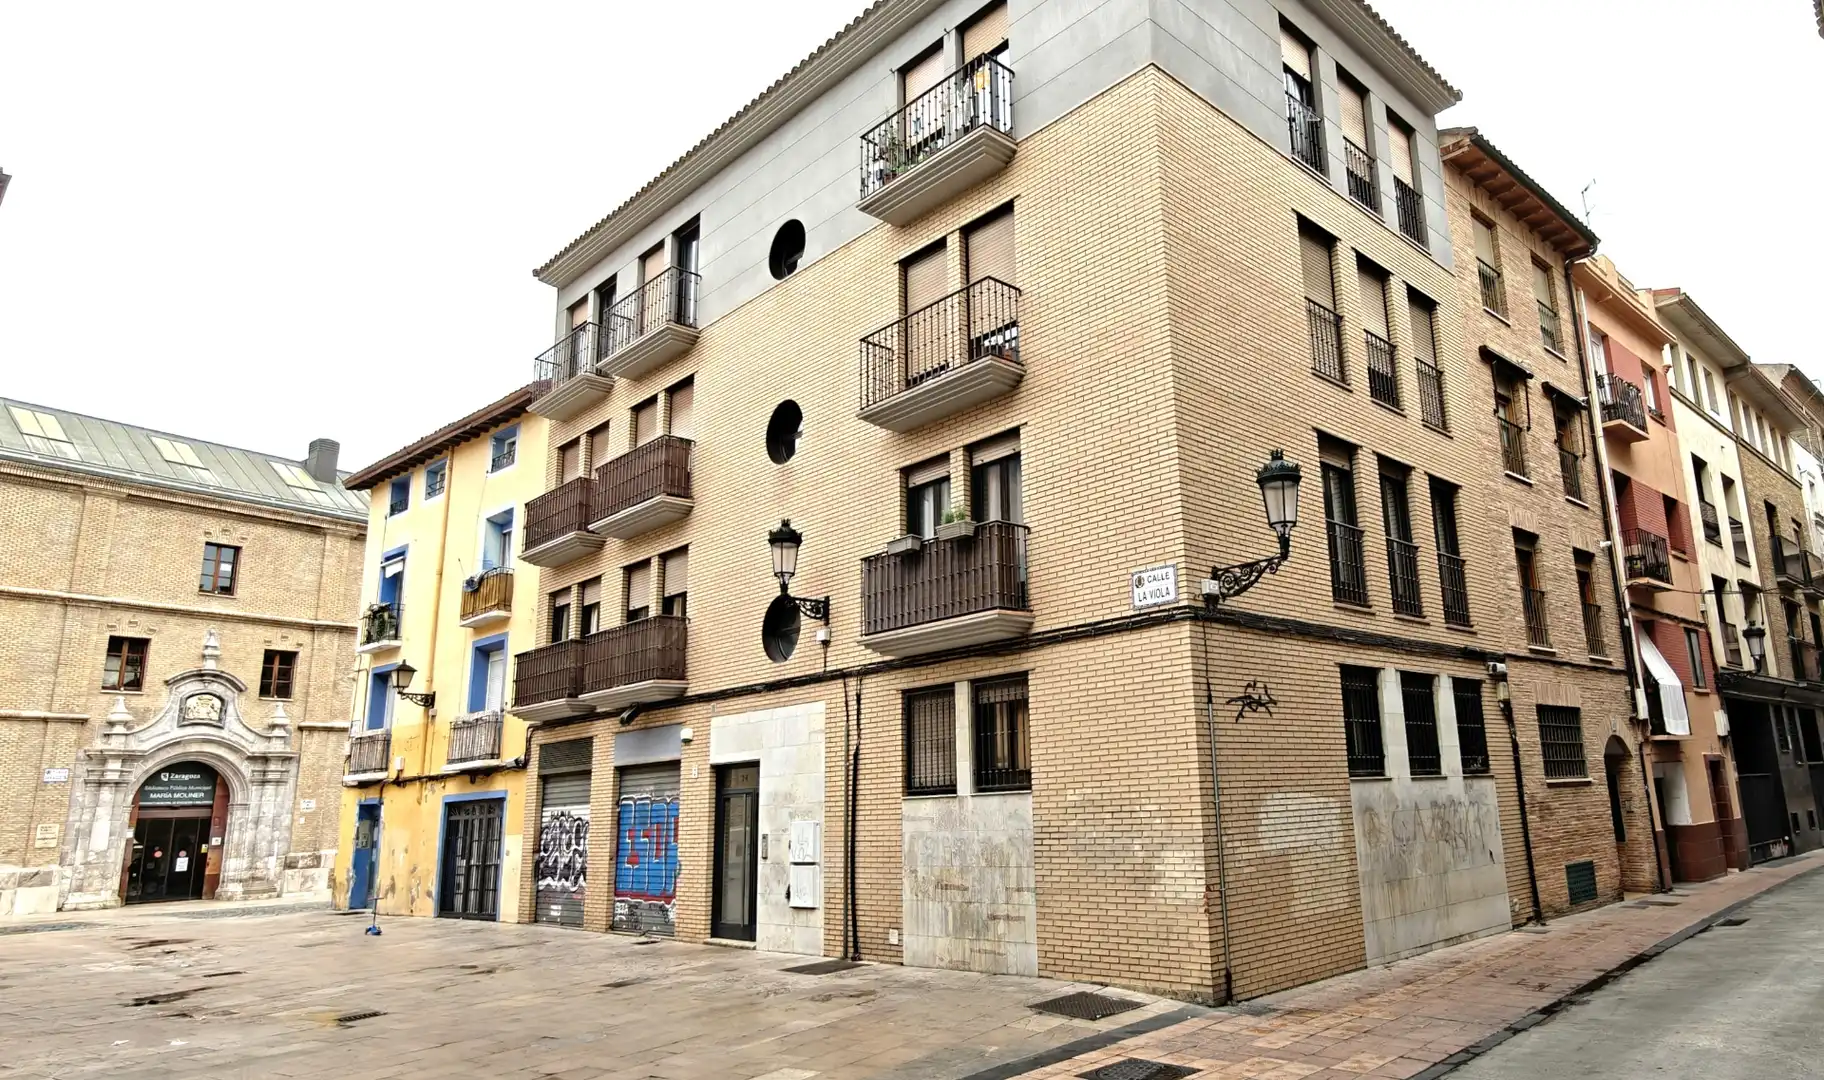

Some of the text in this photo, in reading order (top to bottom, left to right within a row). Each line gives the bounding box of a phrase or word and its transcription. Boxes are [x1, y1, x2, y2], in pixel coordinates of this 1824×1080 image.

[1147, 571, 1170, 583] CALLE
[1138, 586, 1170, 602] LA VIOLA
